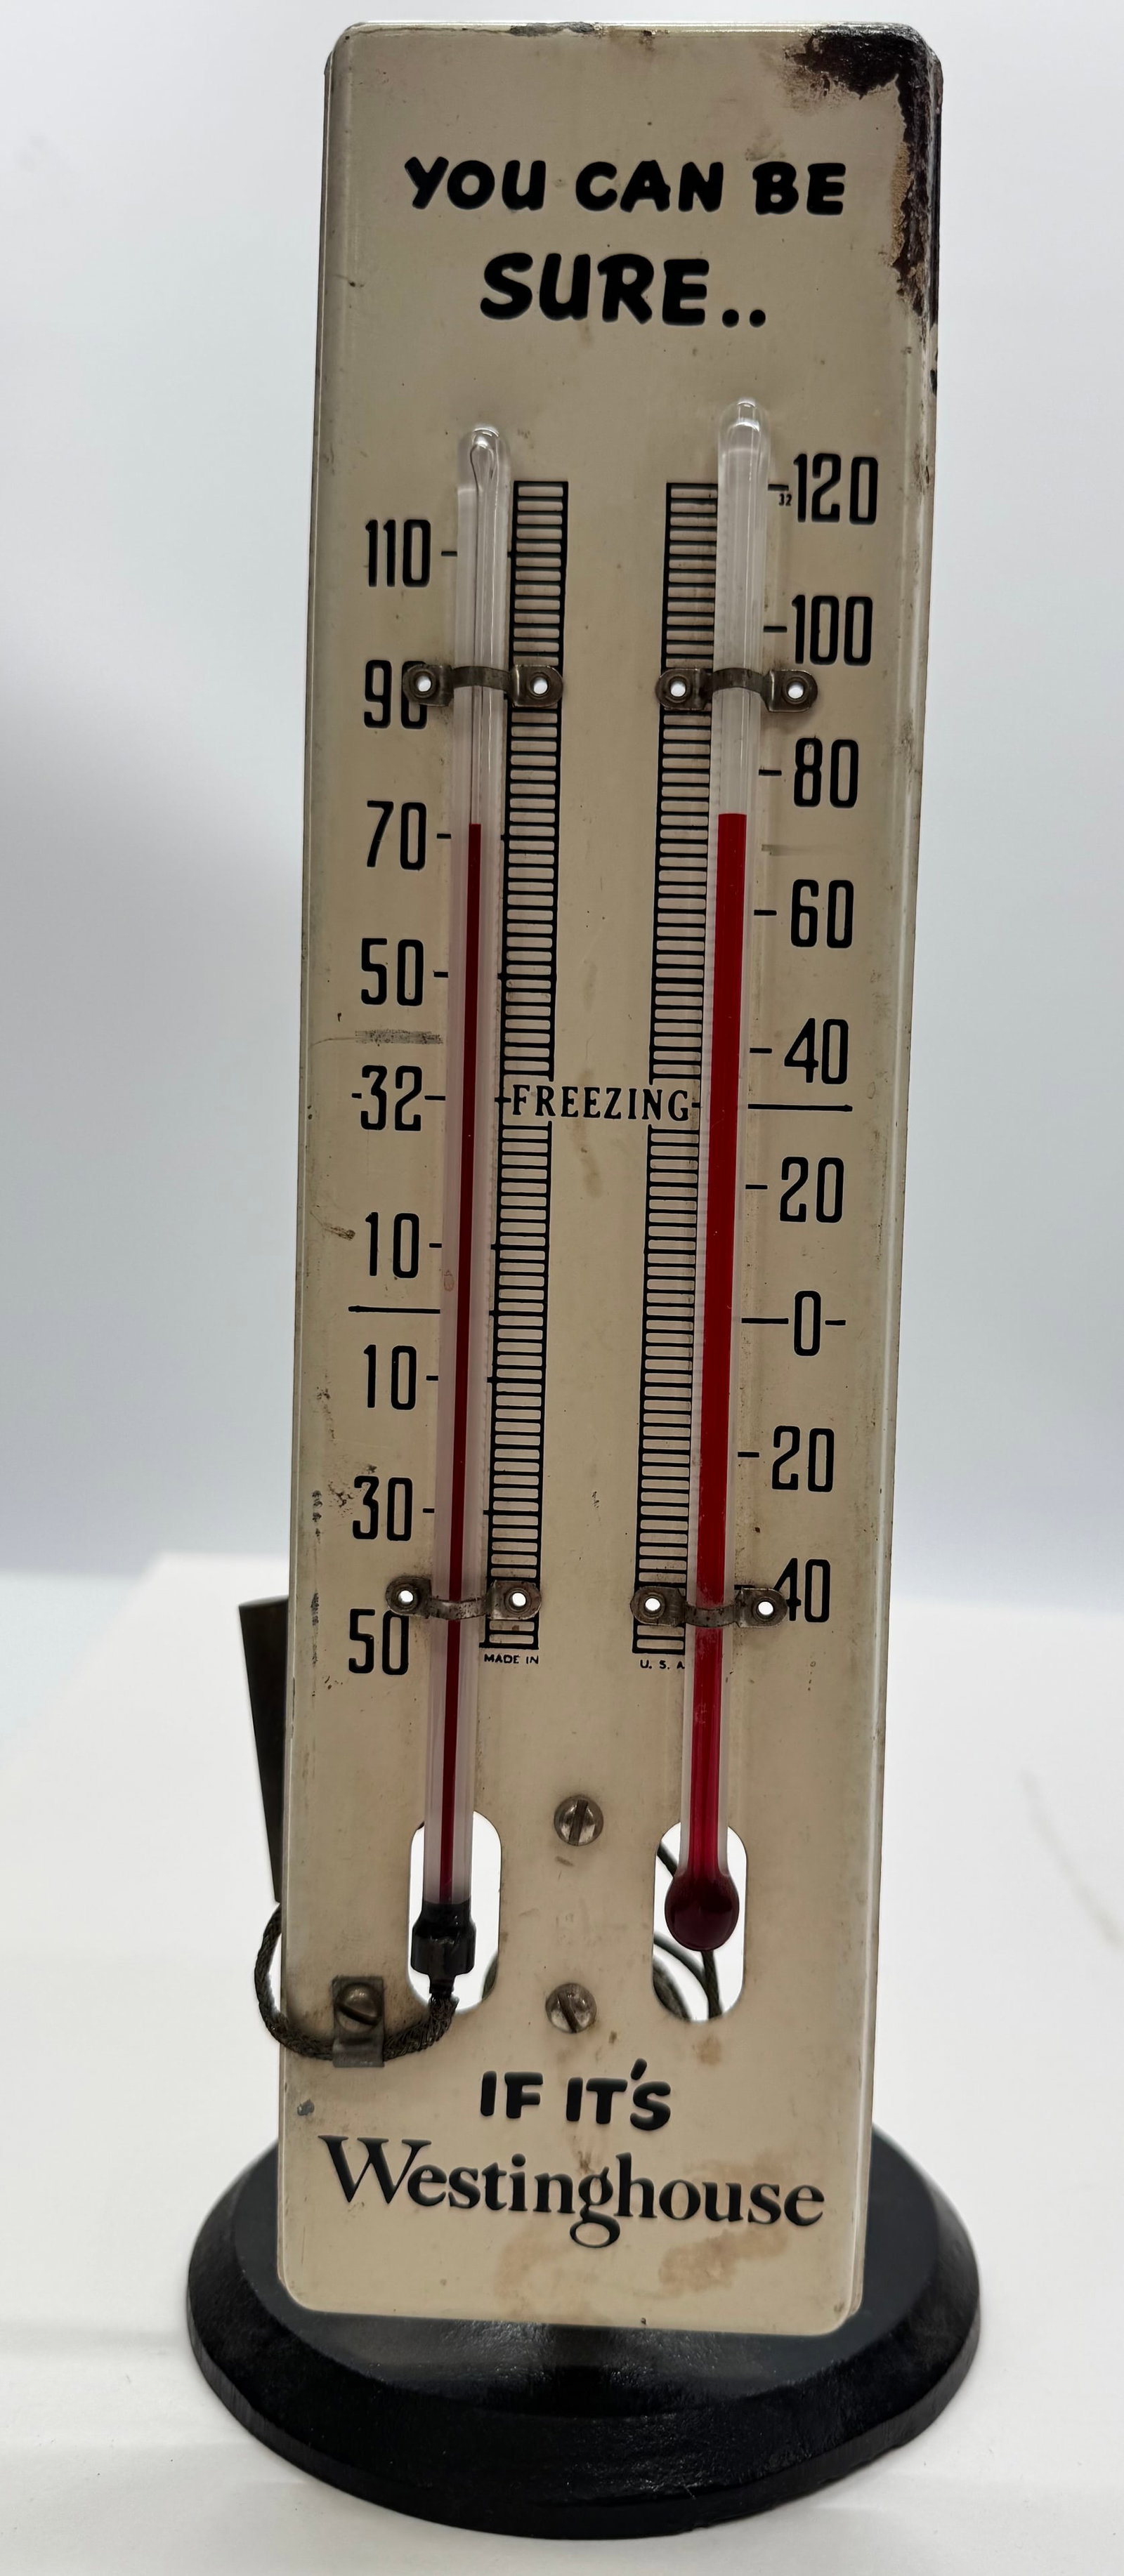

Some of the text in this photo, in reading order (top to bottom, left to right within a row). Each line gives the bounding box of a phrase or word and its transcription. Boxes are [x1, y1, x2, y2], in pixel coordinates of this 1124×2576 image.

[405, 155, 847, 216] YOU CAN BE
[479, 251, 767, 328] SURE..
[793, 452, 880, 525] 120
[365, 519, 431, 588] 110
[790, 594, 874, 666] 100
[793, 737, 859, 808] 80
[366, 800, 427, 871] 70
[790, 879, 854, 949] 60
[360, 938, 424, 1006] 50
[784, 1017, 849, 1085] 40
[360, 1065, 423, 1132] 32
[512, 1084, 690, 1122] FREEZING
[780, 1156, 844, 1223] 20
[365, 1211, 420, 1279] 10
[362, 1344, 417, 1410] 10
[772, 1425, 835, 1492] 20
[353, 1476, 413, 1542] 30
[773, 1557, 831, 1623] 40
[348, 1608, 410, 1676] 50
[484, 1653, 539, 1664] MADE IN
[480, 2058, 672, 2131] IF IT'S
[318, 2134, 825, 2249] Westinghouse
